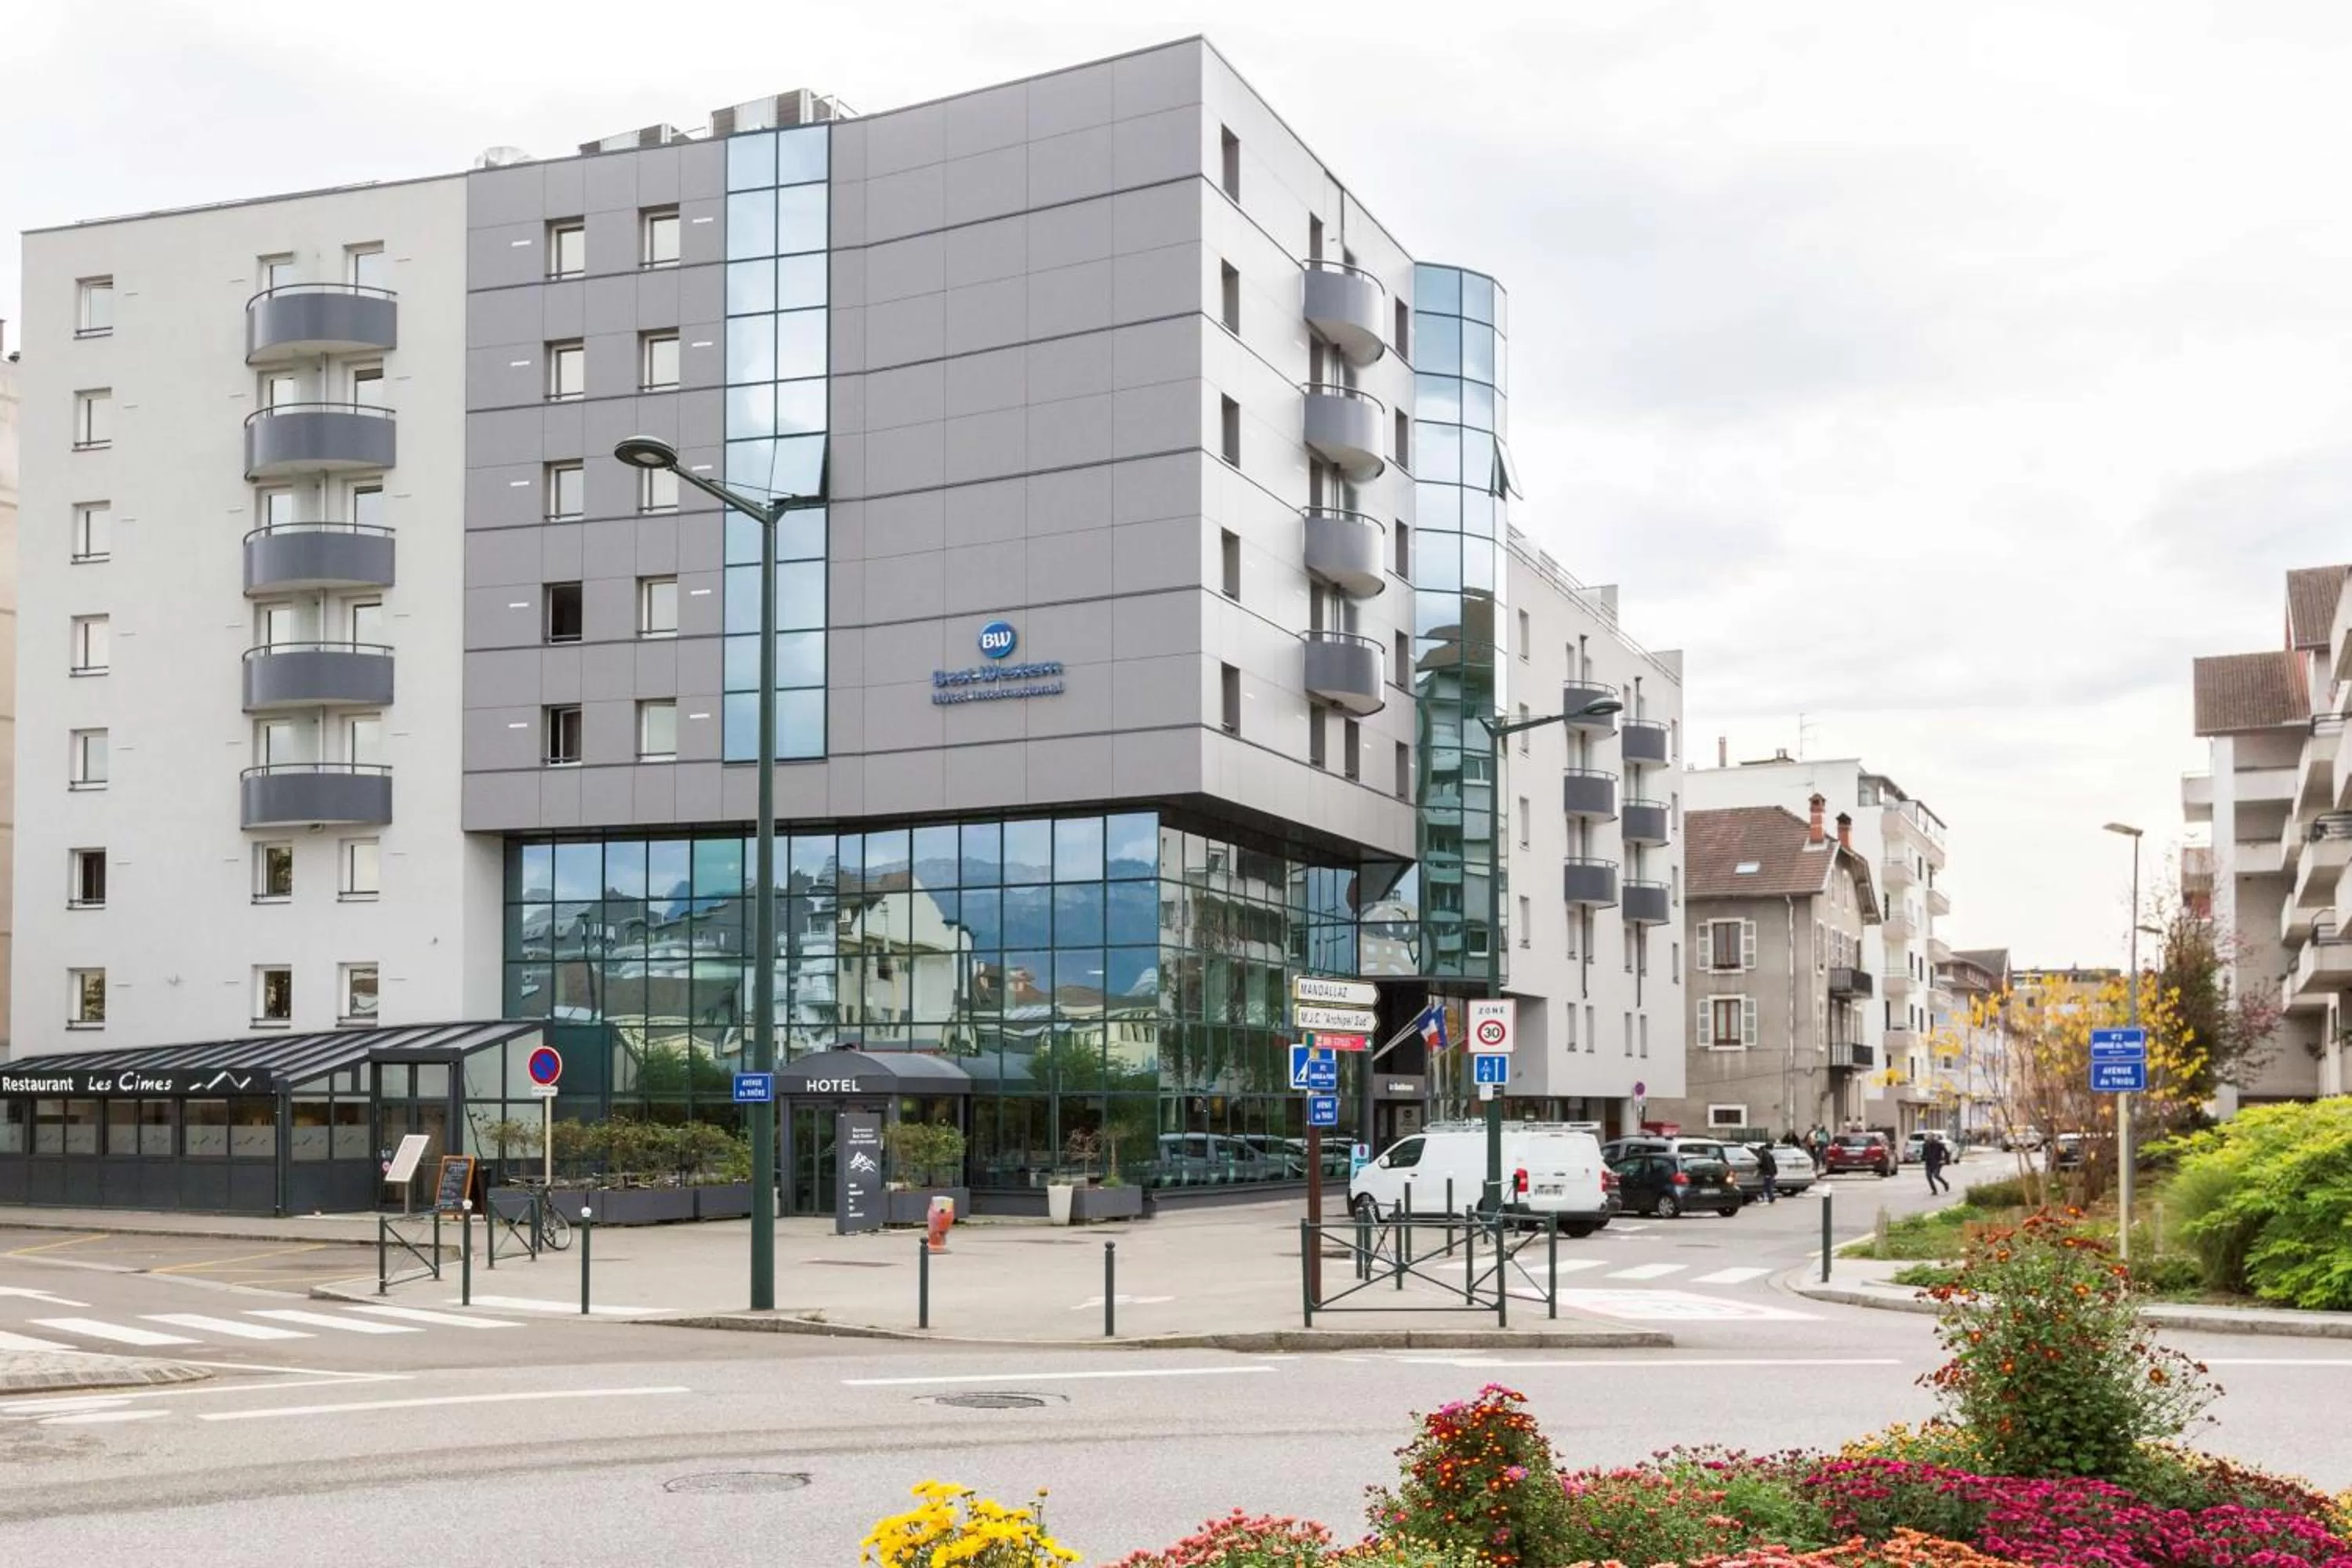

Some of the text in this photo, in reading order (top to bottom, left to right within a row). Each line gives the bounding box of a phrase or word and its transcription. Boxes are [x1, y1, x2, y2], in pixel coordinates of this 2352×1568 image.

[982, 631, 1011, 649] BW
[933, 661, 1063, 687] Best Western
[974, 681, 1064, 700] International
[1301, 984, 1348, 998] MANDALLAZ
[1478, 1006, 1505, 1014] ZONE
[1483, 1026, 1500, 1038] 30
[2102, 1065, 2132, 1075] AVENUE
[2, 1071, 172, 1091] Restaurant Les Cimes
[806, 1079, 862, 1092] HOTEL
[2111, 1076, 2135, 1086] THIOU
